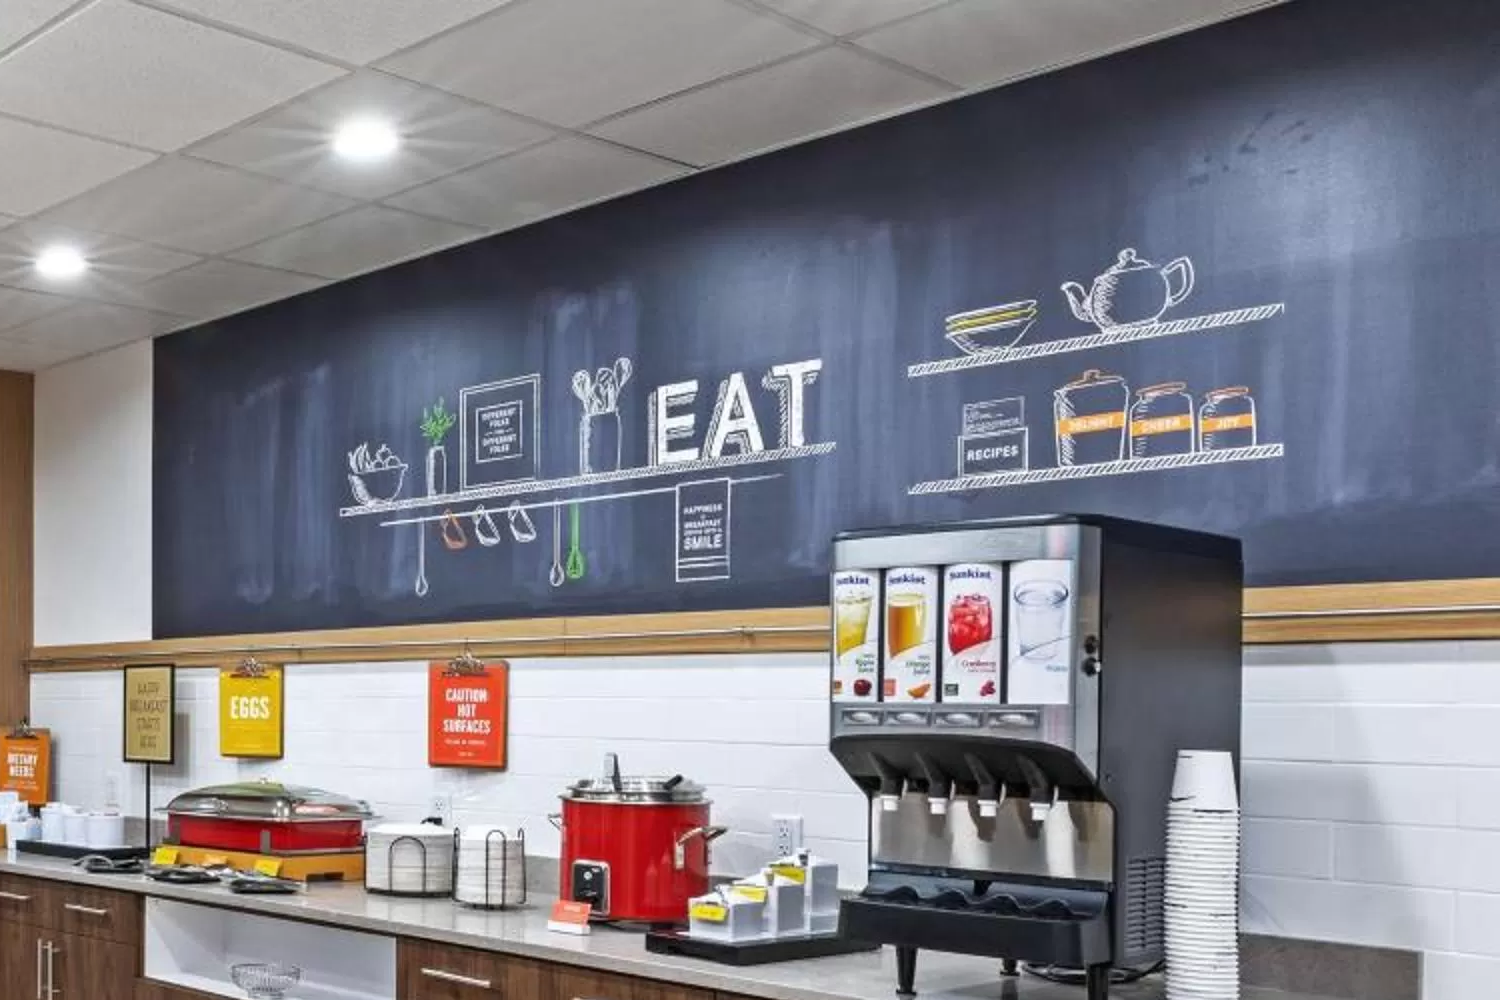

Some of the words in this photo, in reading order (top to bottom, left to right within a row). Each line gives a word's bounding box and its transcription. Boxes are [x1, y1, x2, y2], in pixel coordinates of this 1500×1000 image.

[648, 358, 823, 467] EAT
[967, 444, 1019, 461] RECIPES
[683, 533, 722, 551] SMILE
[445, 688, 488, 703] CAUTION
[231, 695, 269, 720] EGGS
[457, 703, 477, 718] HOT
[443, 719, 491, 735] SURFACES
